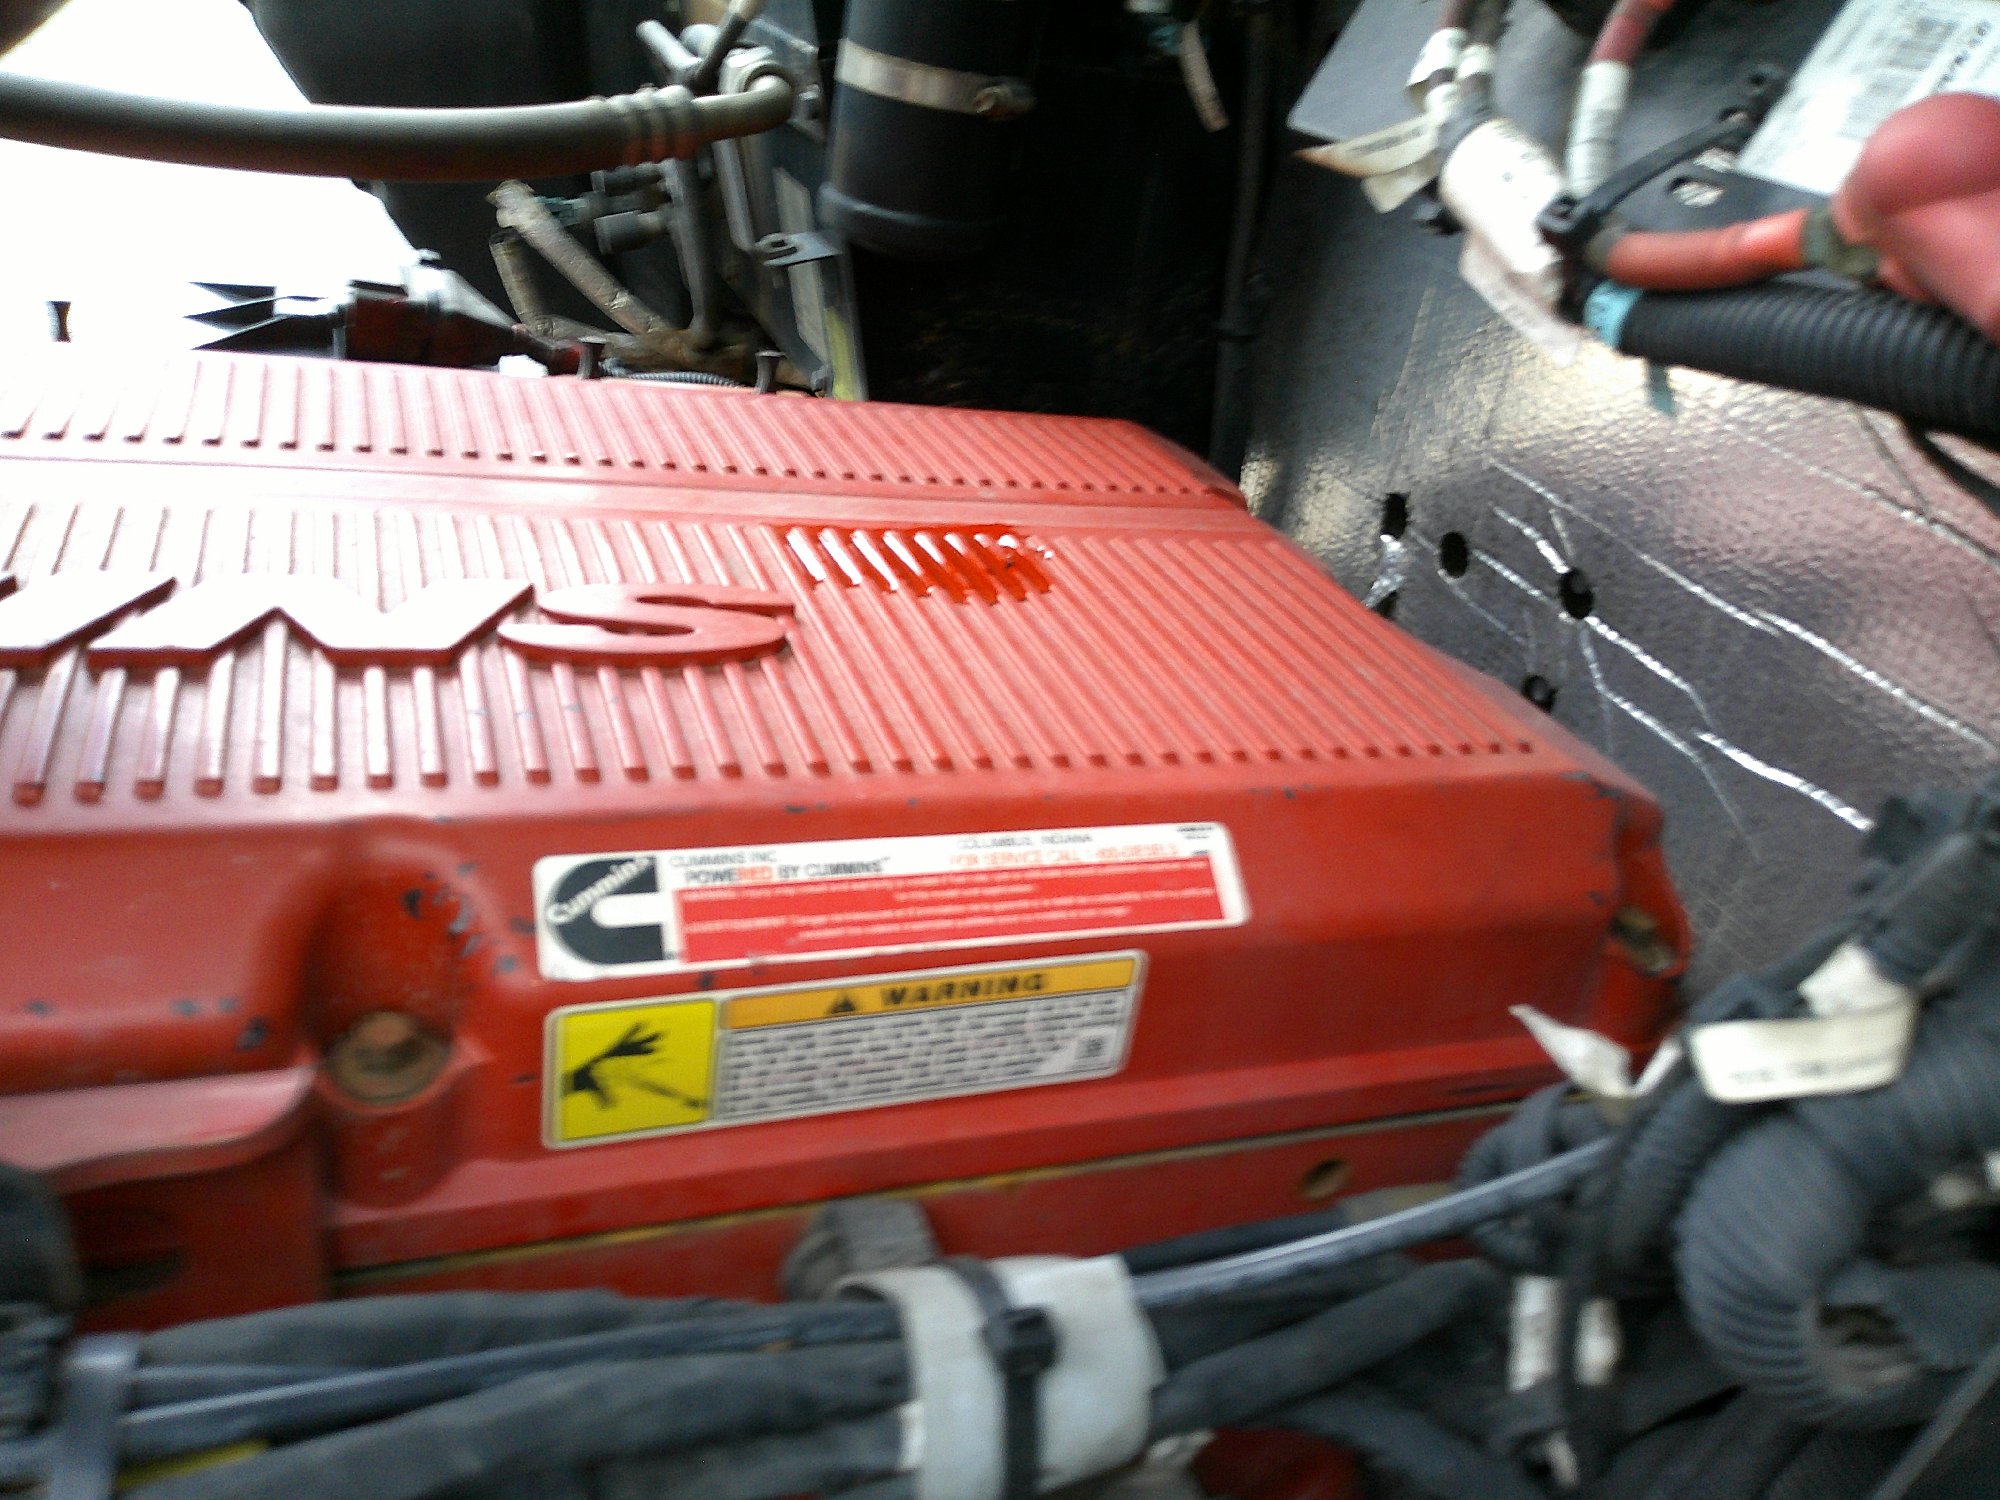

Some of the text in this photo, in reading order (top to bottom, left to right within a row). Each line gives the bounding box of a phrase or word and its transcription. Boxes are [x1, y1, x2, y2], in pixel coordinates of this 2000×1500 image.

[0, 573, 797, 667] INS
[670, 850, 746, 867] CUMMINS
[685, 865, 774, 882] POWERED
[778, 864, 800, 879] BY
[545, 858, 651, 924] Cummins
[881, 973, 1046, 1006] WARNING
